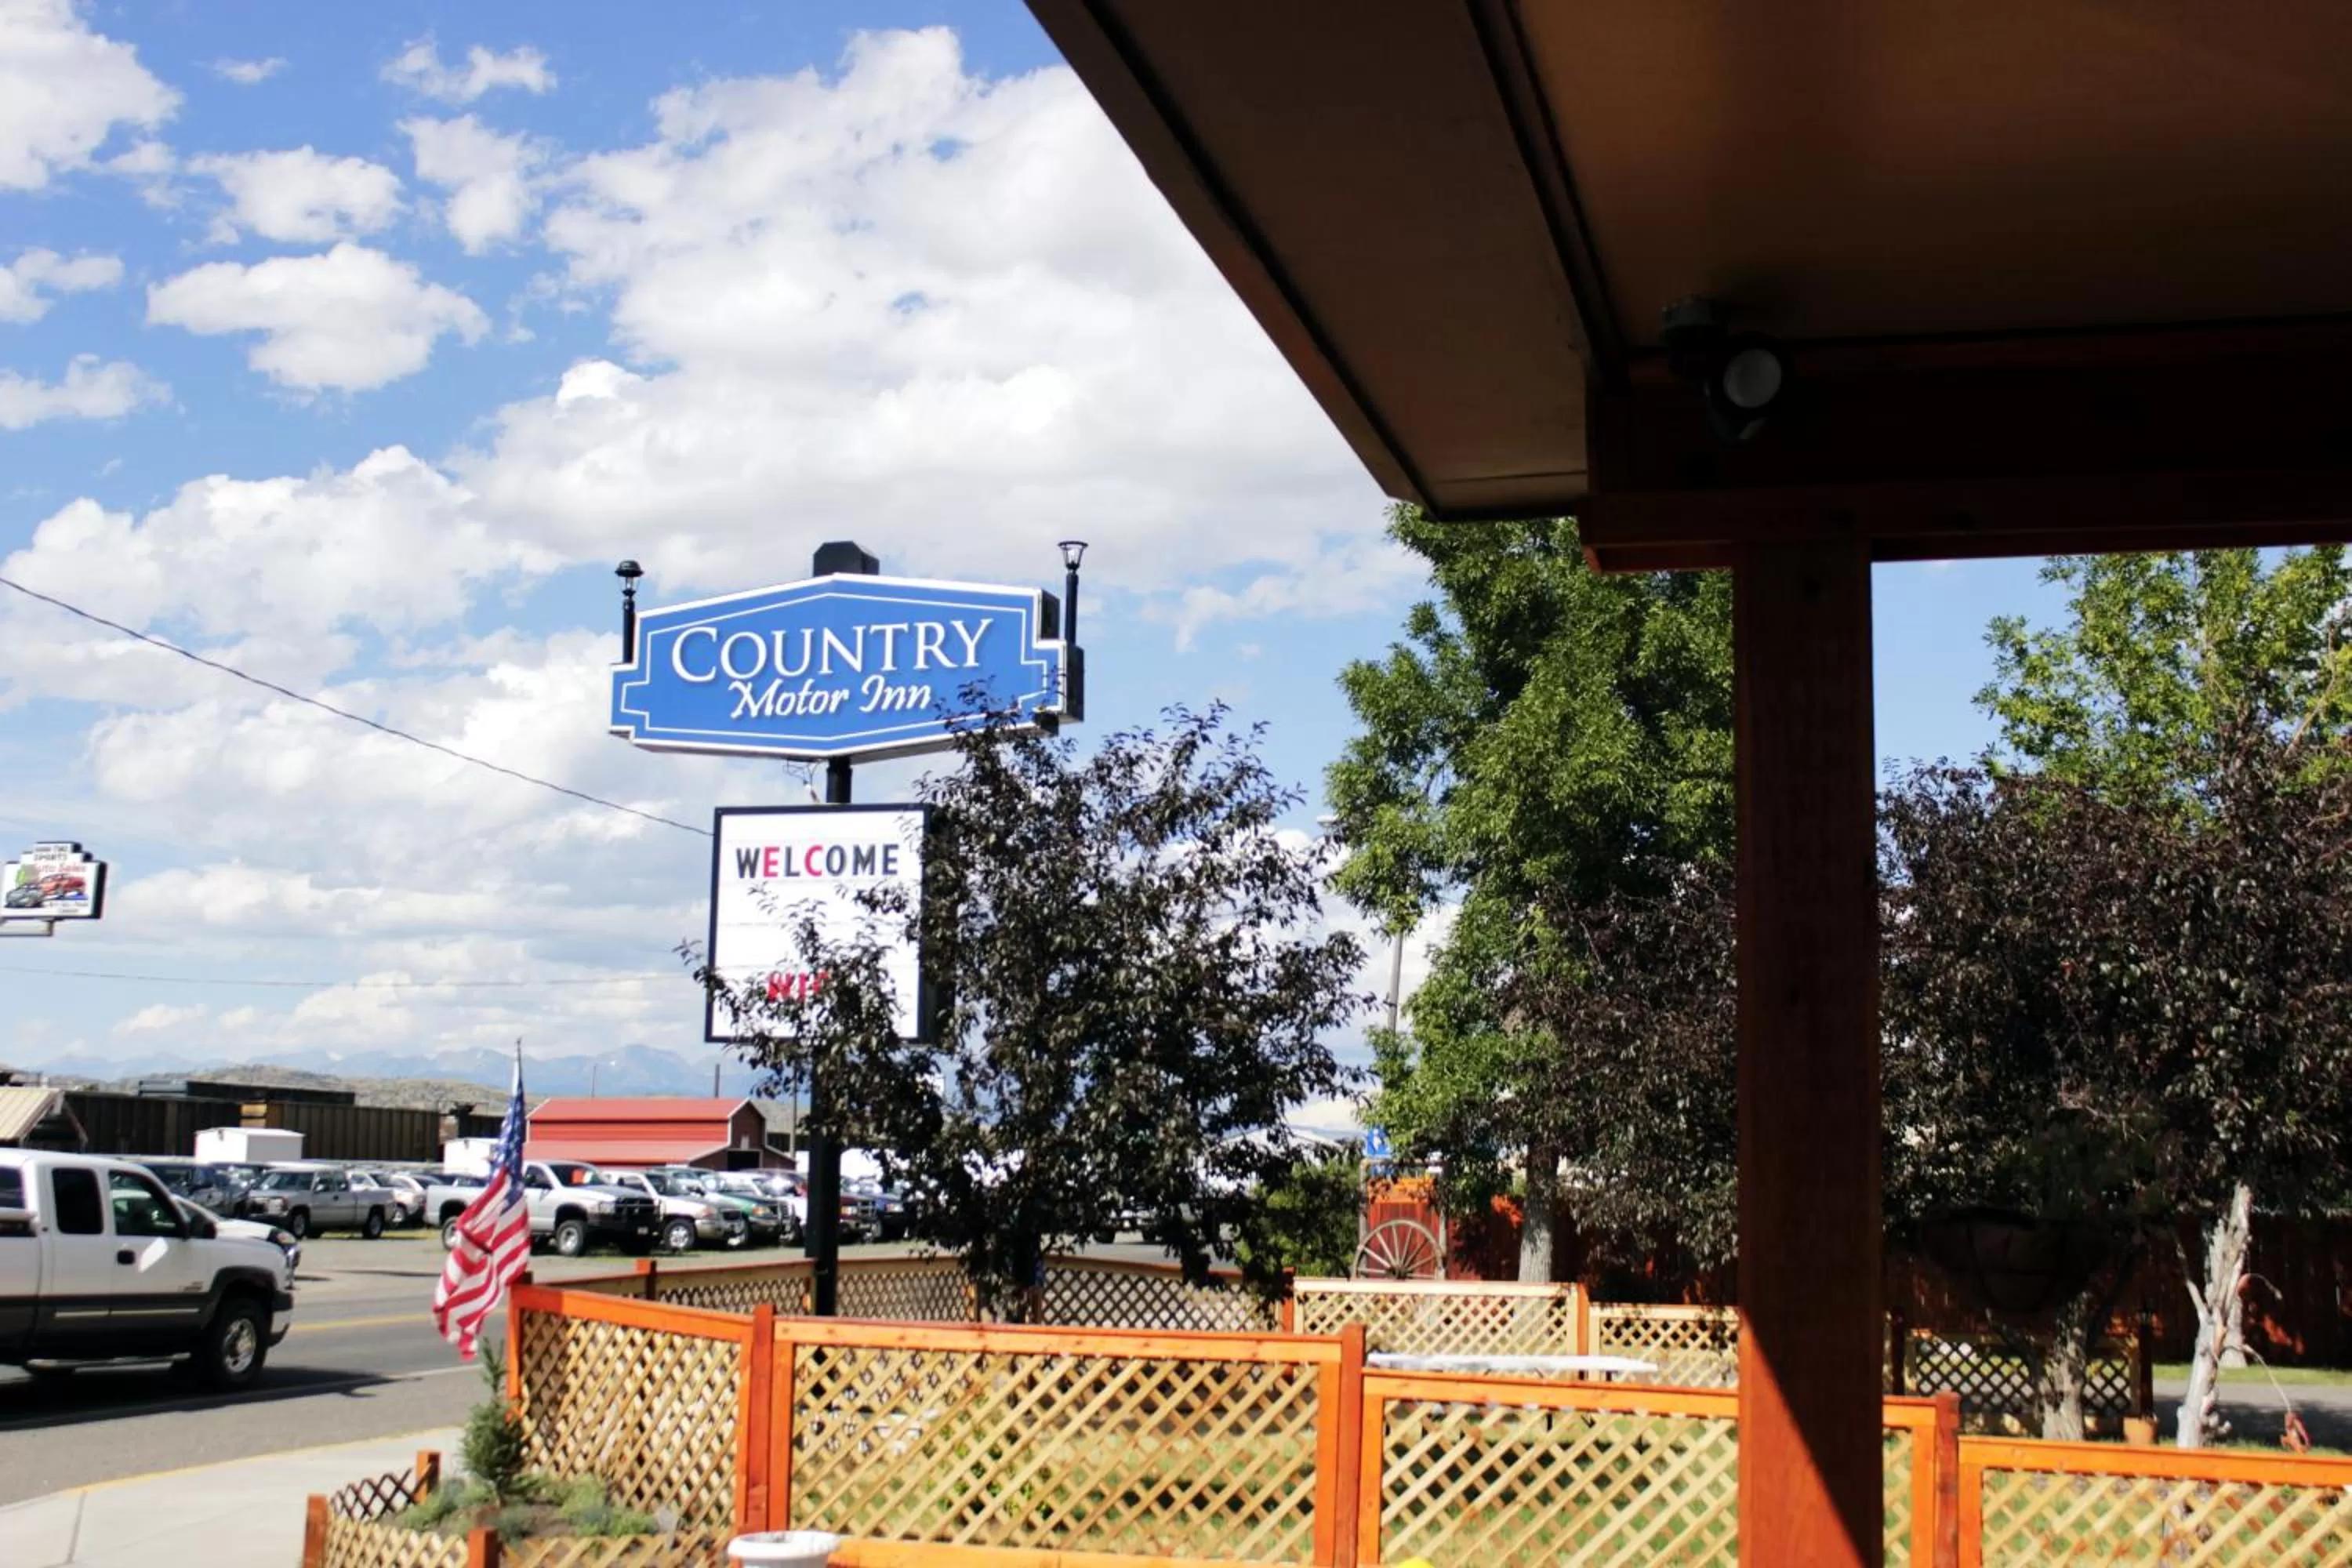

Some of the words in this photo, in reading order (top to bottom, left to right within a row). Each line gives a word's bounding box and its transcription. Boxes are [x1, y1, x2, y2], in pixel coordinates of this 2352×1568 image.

[671, 618, 994, 682] COUNTRY
[728, 677, 849, 719] Motor
[859, 673, 931, 710] Inn
[736, 844, 898, 878] WELCOME
